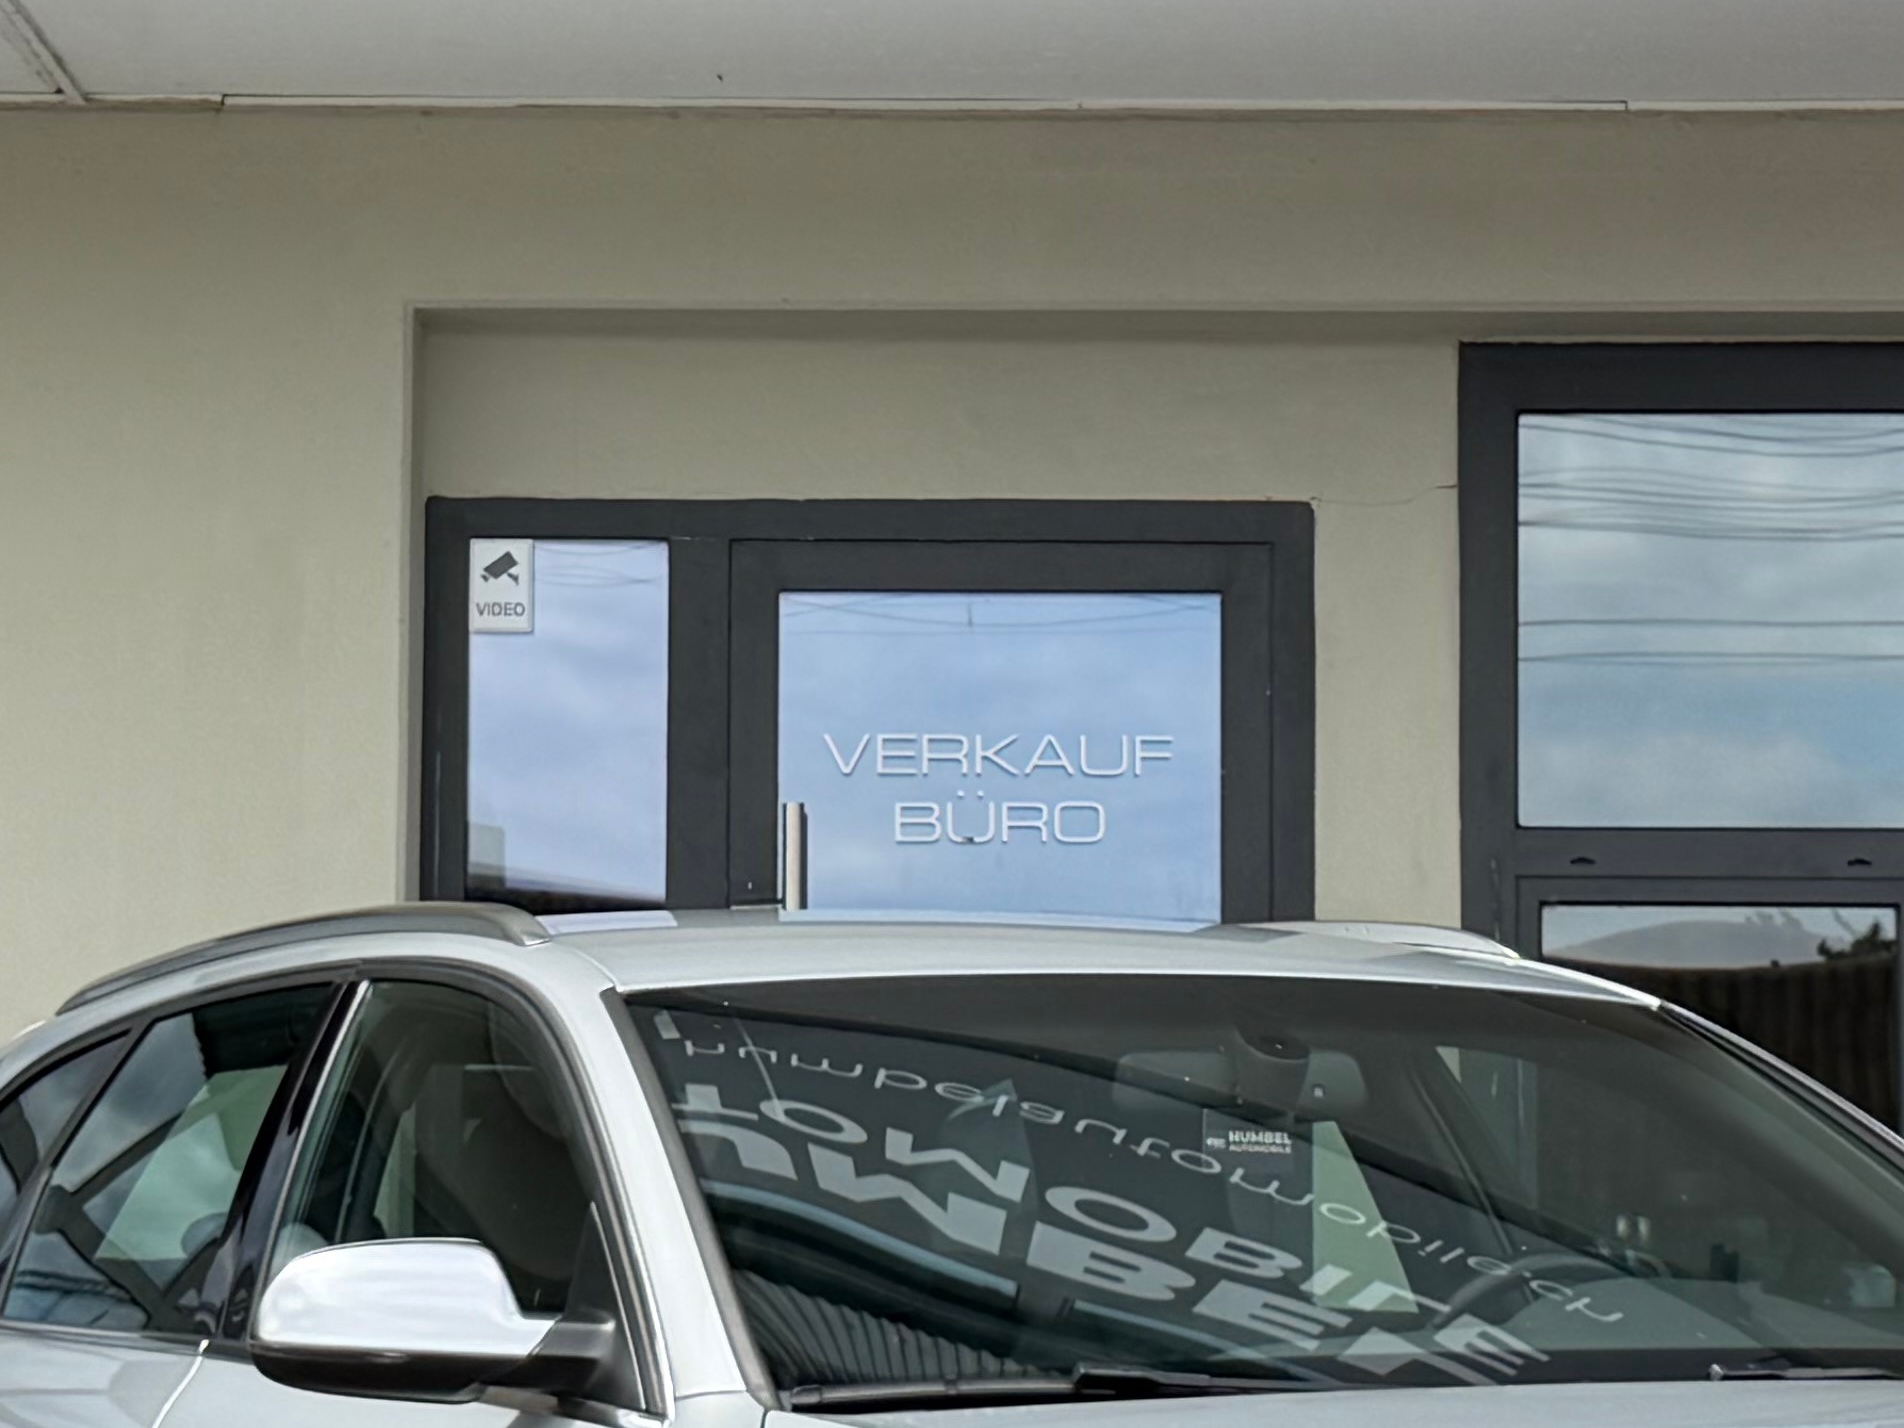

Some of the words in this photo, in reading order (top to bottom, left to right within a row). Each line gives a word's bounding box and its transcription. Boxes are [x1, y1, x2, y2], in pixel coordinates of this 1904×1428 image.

[476, 601, 526, 617] VIDEO
[823, 733, 1174, 777] VERKAUF
[894, 790, 1107, 844] BÜRO
[1228, 1130, 1292, 1145] HUMBEL
